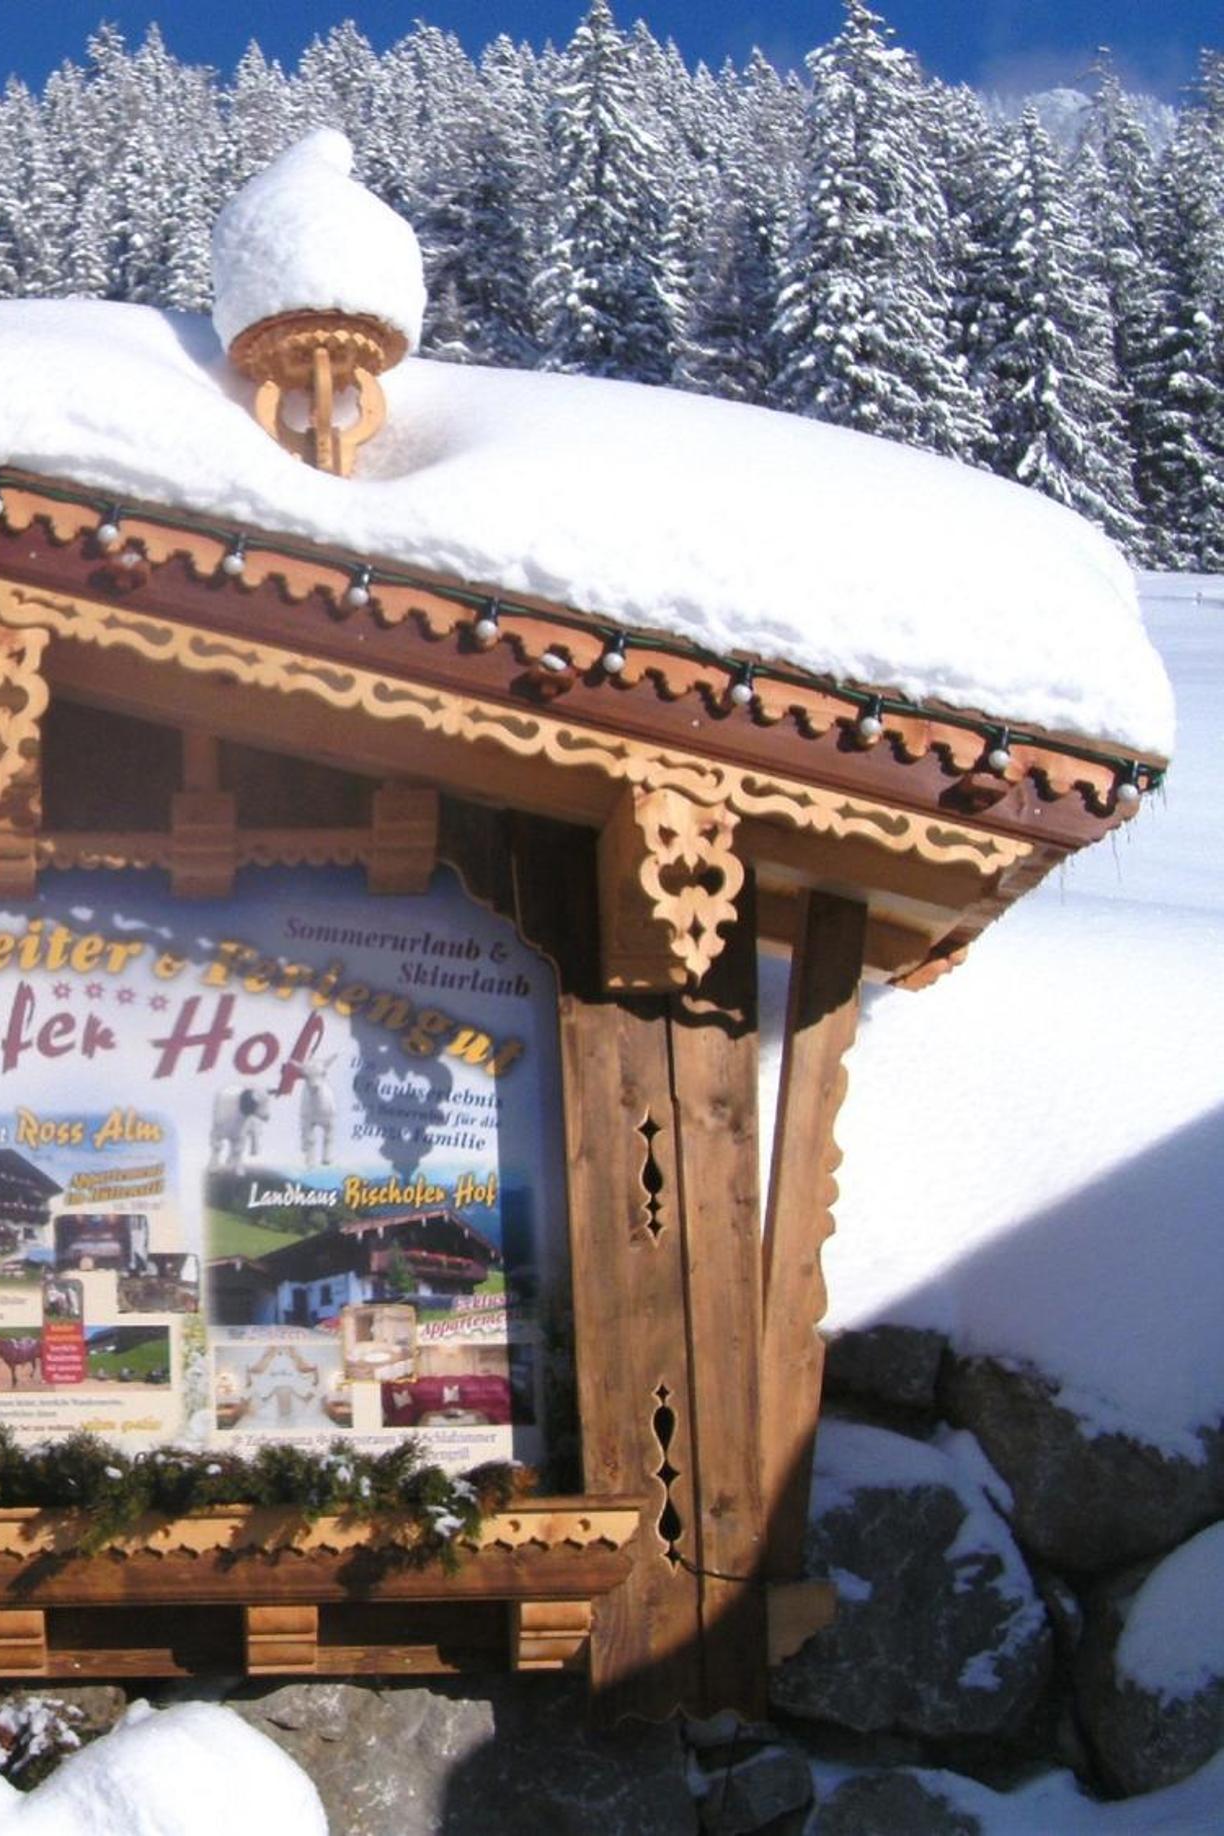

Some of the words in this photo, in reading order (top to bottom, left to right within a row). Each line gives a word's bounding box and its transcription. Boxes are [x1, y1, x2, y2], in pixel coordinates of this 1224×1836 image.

[283, 916, 482, 962] Sommerurlaub
[490, 940, 510, 963] &
[397, 961, 532, 998] Skiurlaub
[154, 951, 192, 980] &
[200, 938, 526, 1080] Feriengut
[150, 992, 325, 1097] Hof
[16, 1105, 86, 1148] Ross
[94, 1105, 165, 1148] Alm
[414, 1125, 487, 1151] Familie
[247, 1181, 338, 1209] Landhaus
[342, 1172, 446, 1209] Bischofer
[453, 1172, 499, 1208] Hof
